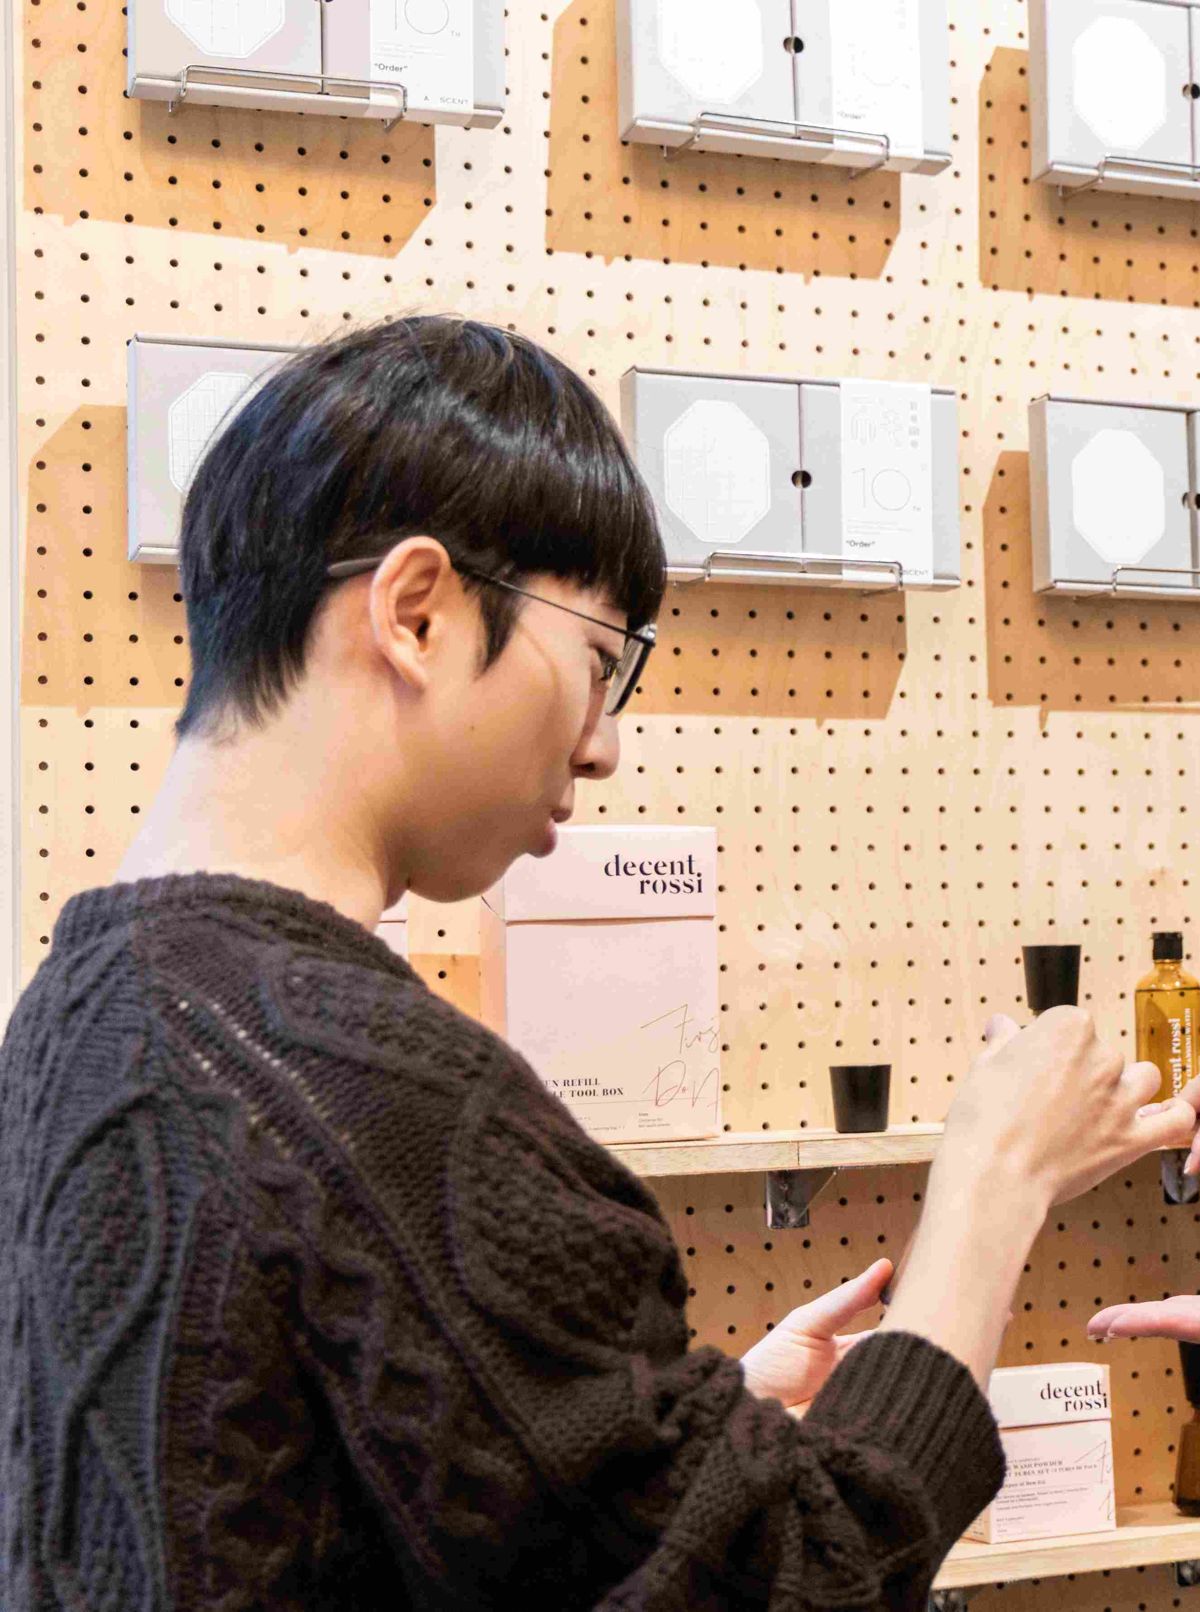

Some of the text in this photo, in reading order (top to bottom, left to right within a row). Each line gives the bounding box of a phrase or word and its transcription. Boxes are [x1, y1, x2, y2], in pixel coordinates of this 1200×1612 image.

[439, 96, 469, 105] SCENT
[603, 853, 698, 877] decent
[638, 872, 703, 895] rossi
[1167, 1017, 1182, 1098] ecent rossi
[563, 1078, 600, 1087] REFILL
[569, 1088, 599, 1098] TOOL
[602, 1087, 624, 1097] BOX
[1040, 1379, 1104, 1400] decent
[1064, 1392, 1109, 1413] rossi
